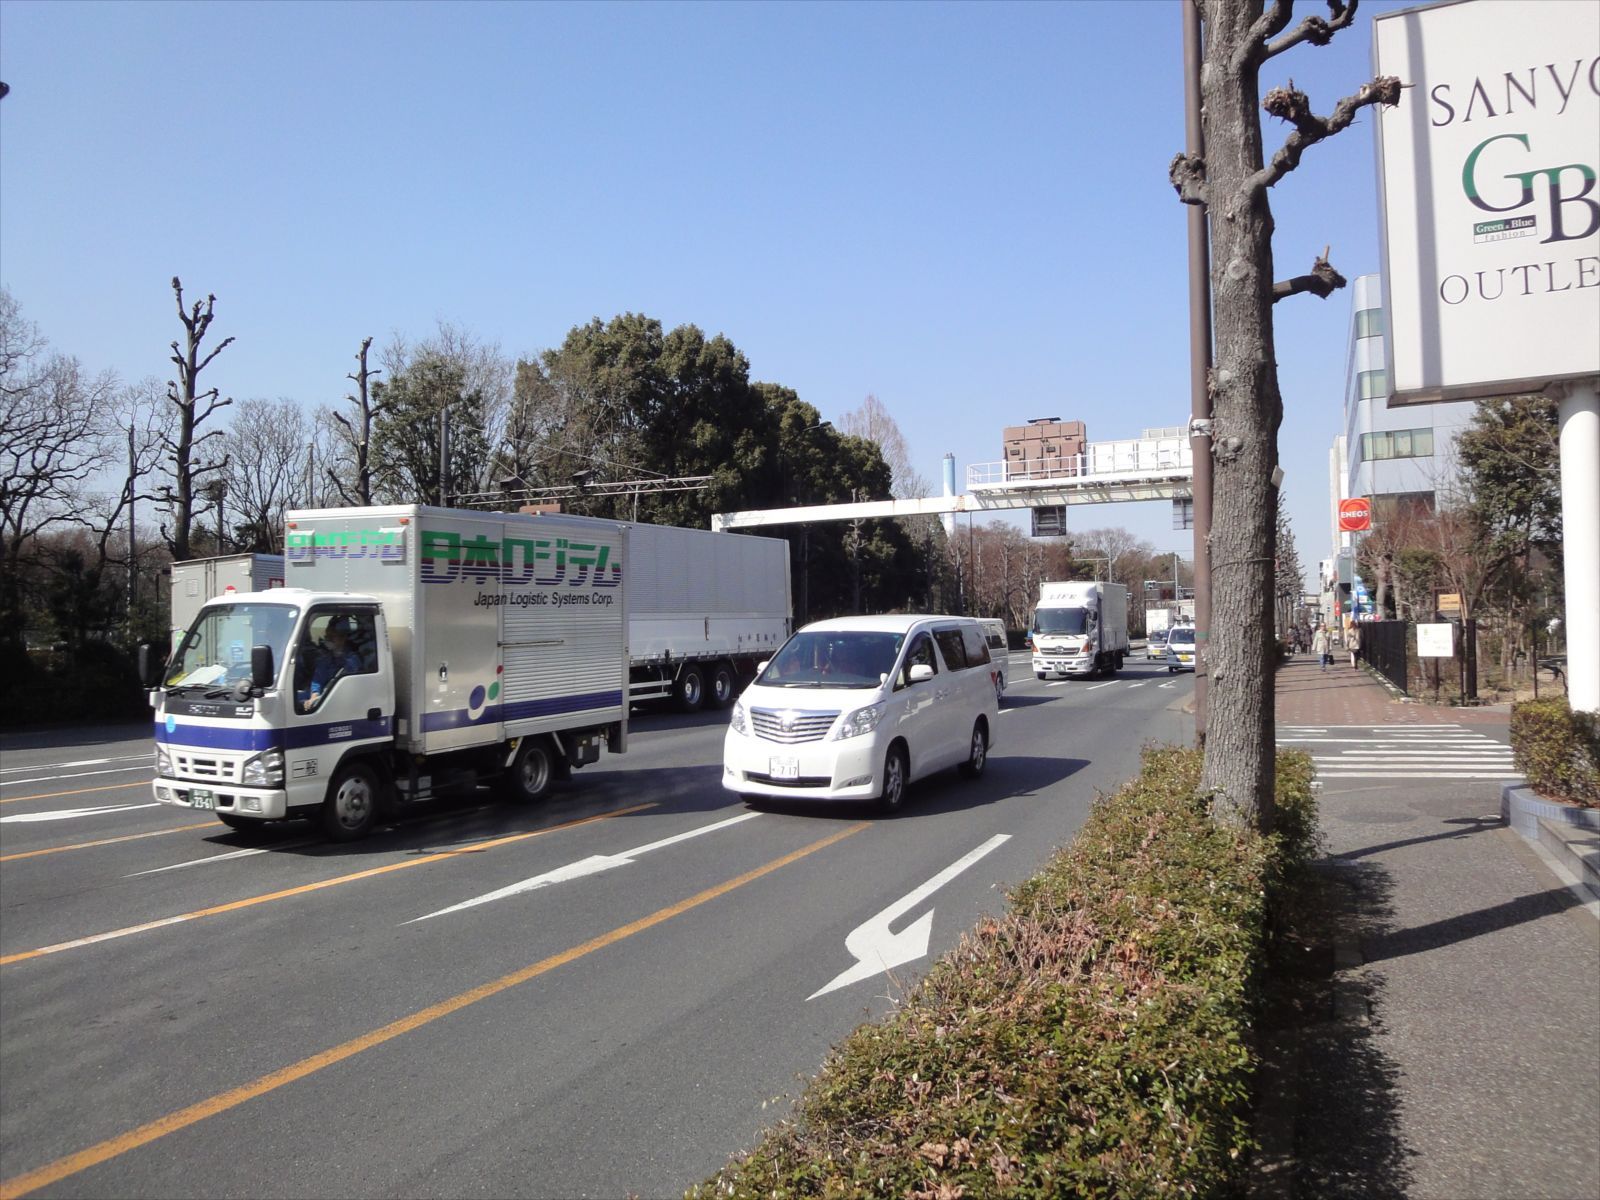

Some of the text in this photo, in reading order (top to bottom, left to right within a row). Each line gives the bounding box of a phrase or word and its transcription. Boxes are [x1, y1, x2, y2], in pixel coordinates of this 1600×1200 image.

[1476, 223, 1504, 233] Green
[1511, 218, 1534, 229] Blue
[1485, 230, 1526, 240] fashion
[1341, 510, 1368, 518] ENEOS
[474, 592, 614, 609] Japan Logistic Systems Corp.
